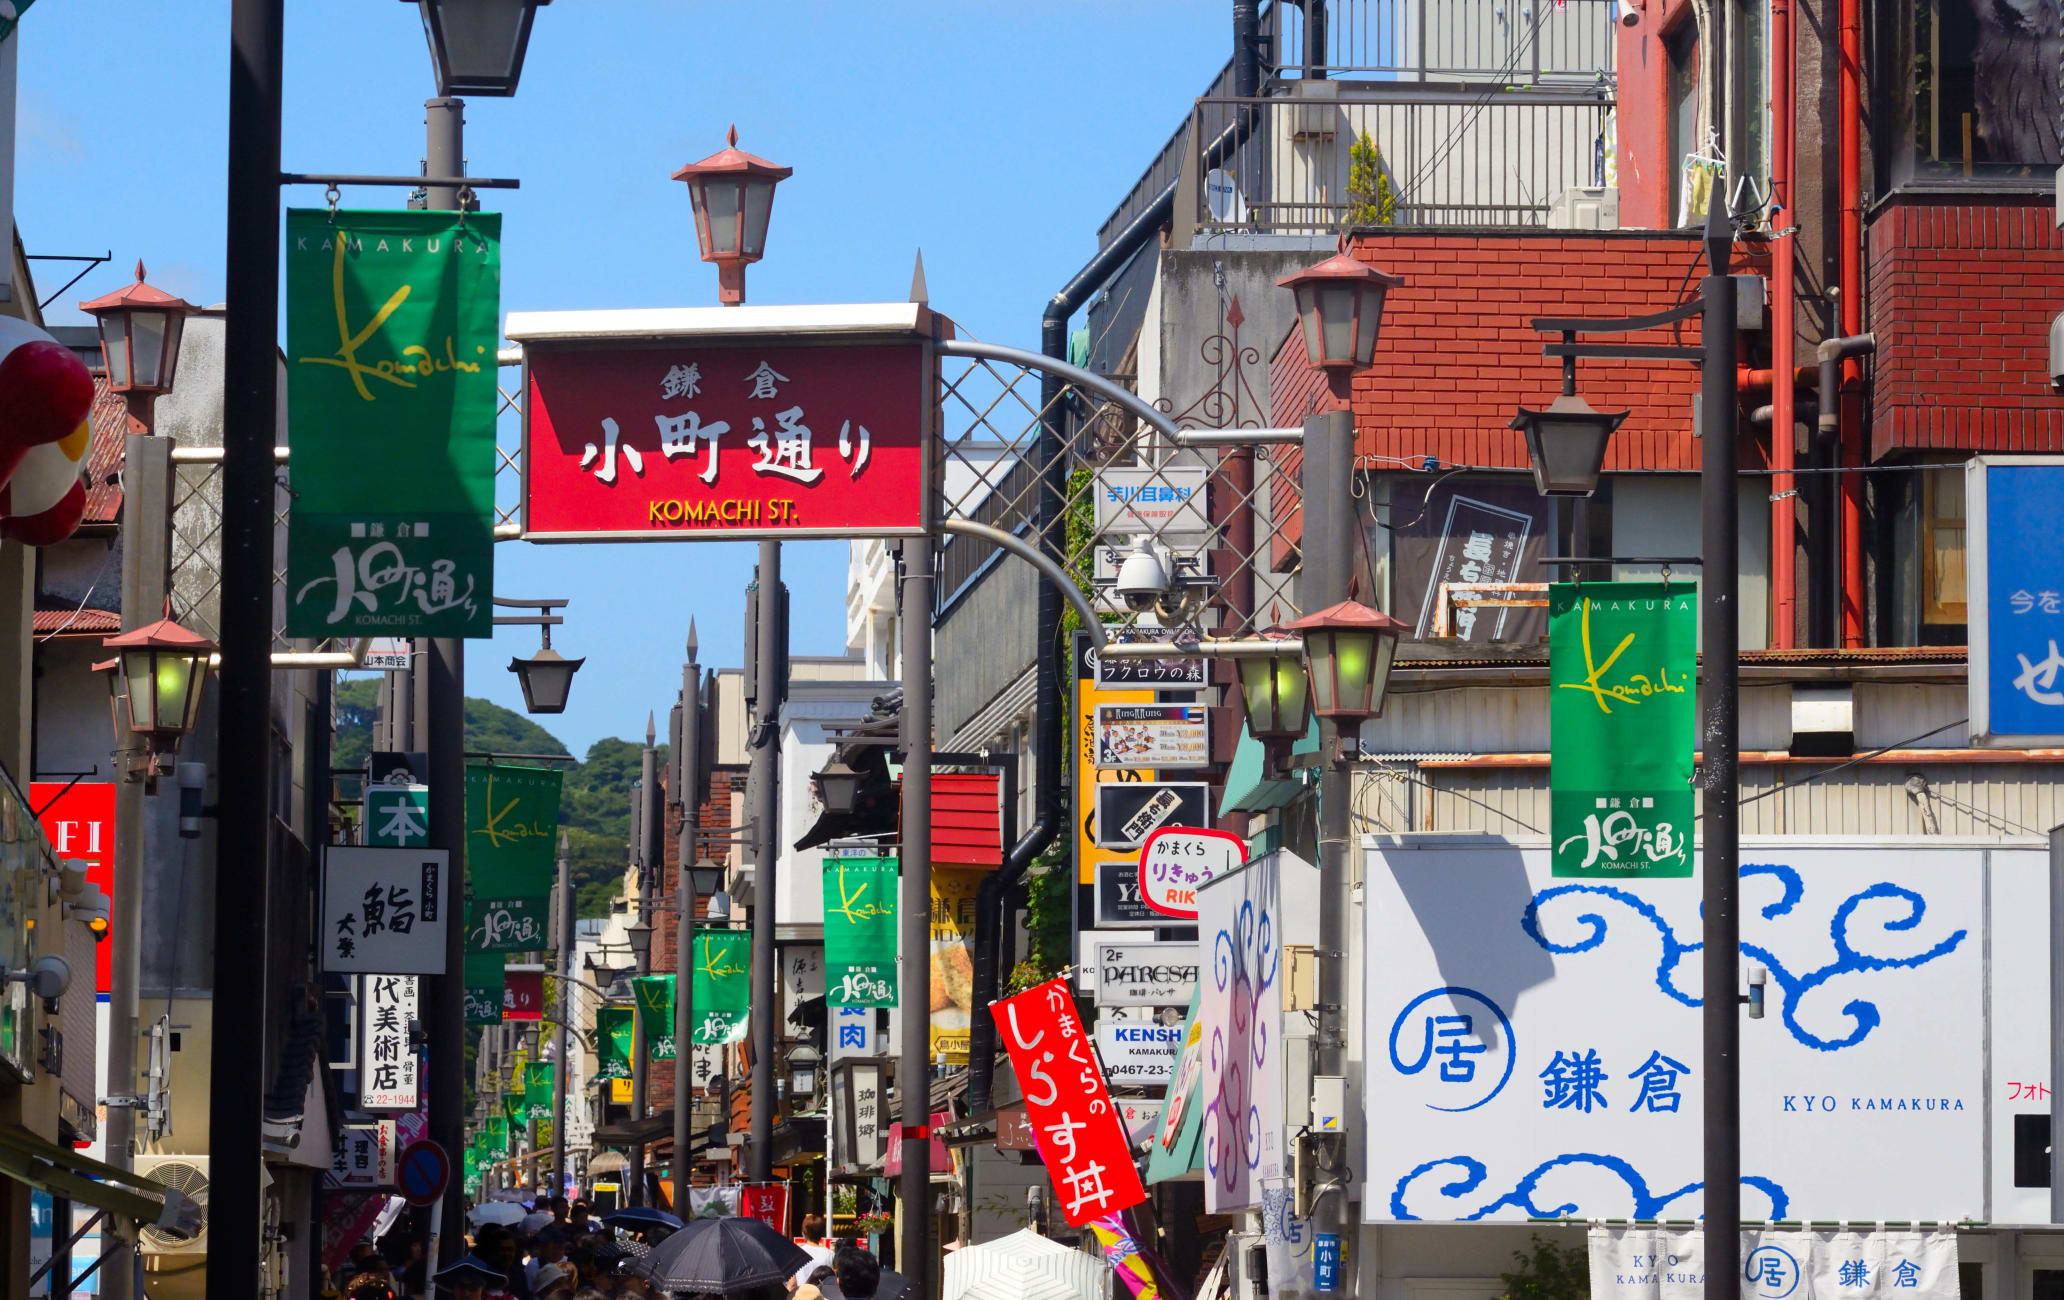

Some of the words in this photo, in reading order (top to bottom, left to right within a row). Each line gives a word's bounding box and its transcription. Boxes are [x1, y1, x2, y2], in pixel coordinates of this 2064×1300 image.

[299, 238, 488, 253] KAMAKURA
[299, 231, 485, 401] Komachi
[660, 361, 790, 400] 鎌倉
[579, 406, 870, 484] 小町通り
[650, 500, 759, 521] KOMACHI
[768, 500, 798, 520] ST.
[1557, 601, 1688, 611] KAMAKURA
[355, 615, 406, 625] KOMACHI
[1559, 597, 1687, 714] Komachi
[1104, 663, 1201, 681] フクロウの森
[1610, 797, 1640, 808] 鎌倉
[378, 797, 426, 847] 本
[1157, 840, 1206, 856] かまくら
[1153, 863, 1214, 884] りきゅう
[1601, 861, 1638, 869] KOMACHI
[1640, 861, 1651, 869] ST.
[362, 881, 415, 937] 鮨
[1106, 949, 1123, 961] 2F
[1047, 984, 1106, 1115] かまくらの
[1539, 1048, 1691, 1113] 鎌倉
[376, 1095, 415, 1104] 22-1944
[2007, 1082, 2051, 1100] フォト
[1008, 1003, 1114, 1217] しらす丼
[1783, 1096, 1836, 1111] KYO
[1852, 1098, 1963, 1110] KAMAKURA
[1634, 1255, 1678, 1267] KYO
[1838, 1258, 1922, 1288] 鎌倉
